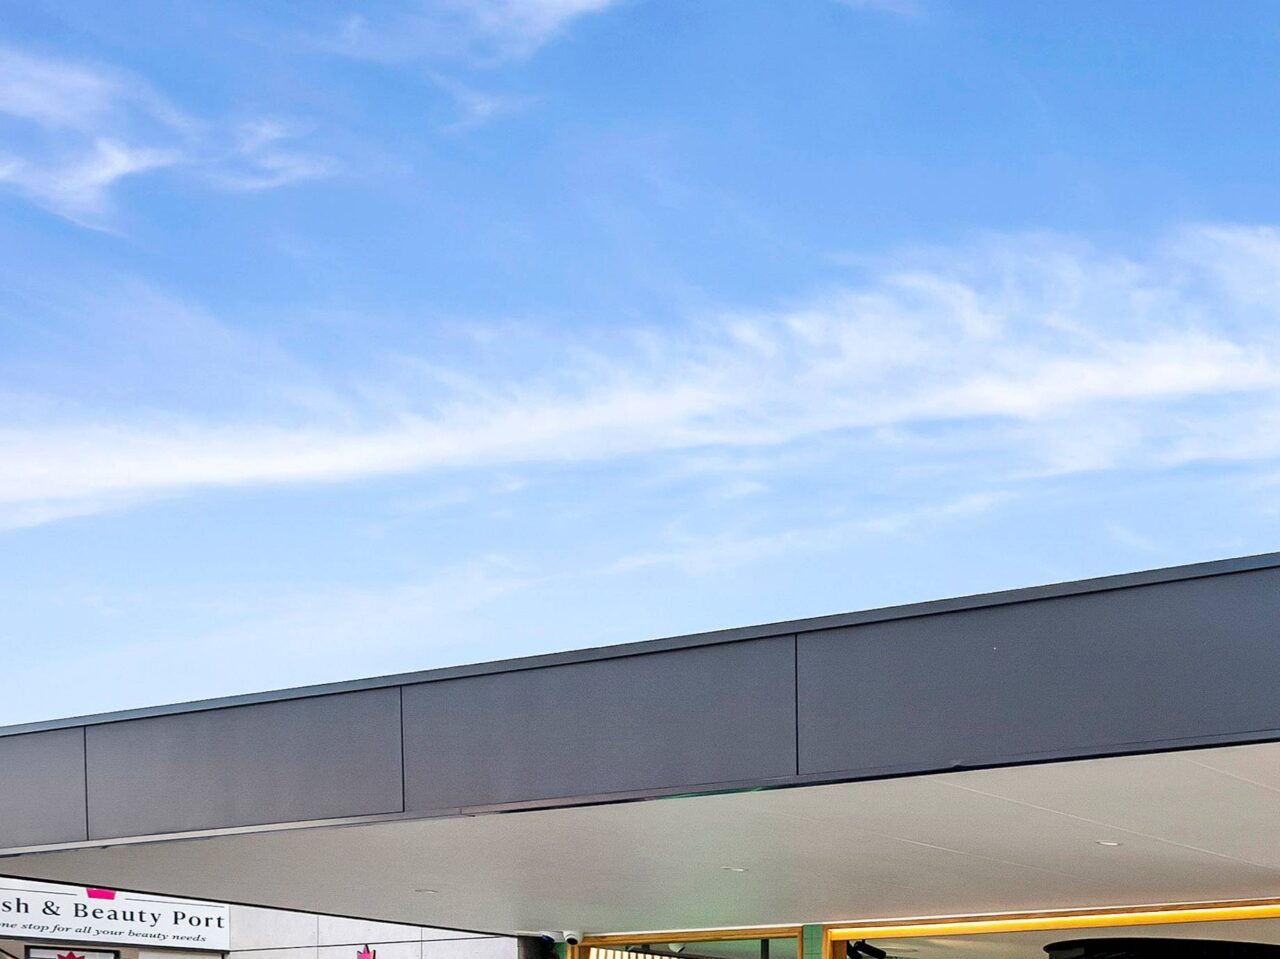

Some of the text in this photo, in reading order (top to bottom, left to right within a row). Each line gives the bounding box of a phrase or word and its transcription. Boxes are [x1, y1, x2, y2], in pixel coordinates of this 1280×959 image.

[42, 900, 61, 916] &
[74, 902, 162, 927] Beauty
[173, 910, 225, 929] Port
[20, 923, 49, 932] stop
[50, 923, 72, 934] for
[75, 926, 92, 934] all
[93, 928, 125, 936] your
[128, 931, 169, 940] beauty
[172, 934, 207, 942] needs
